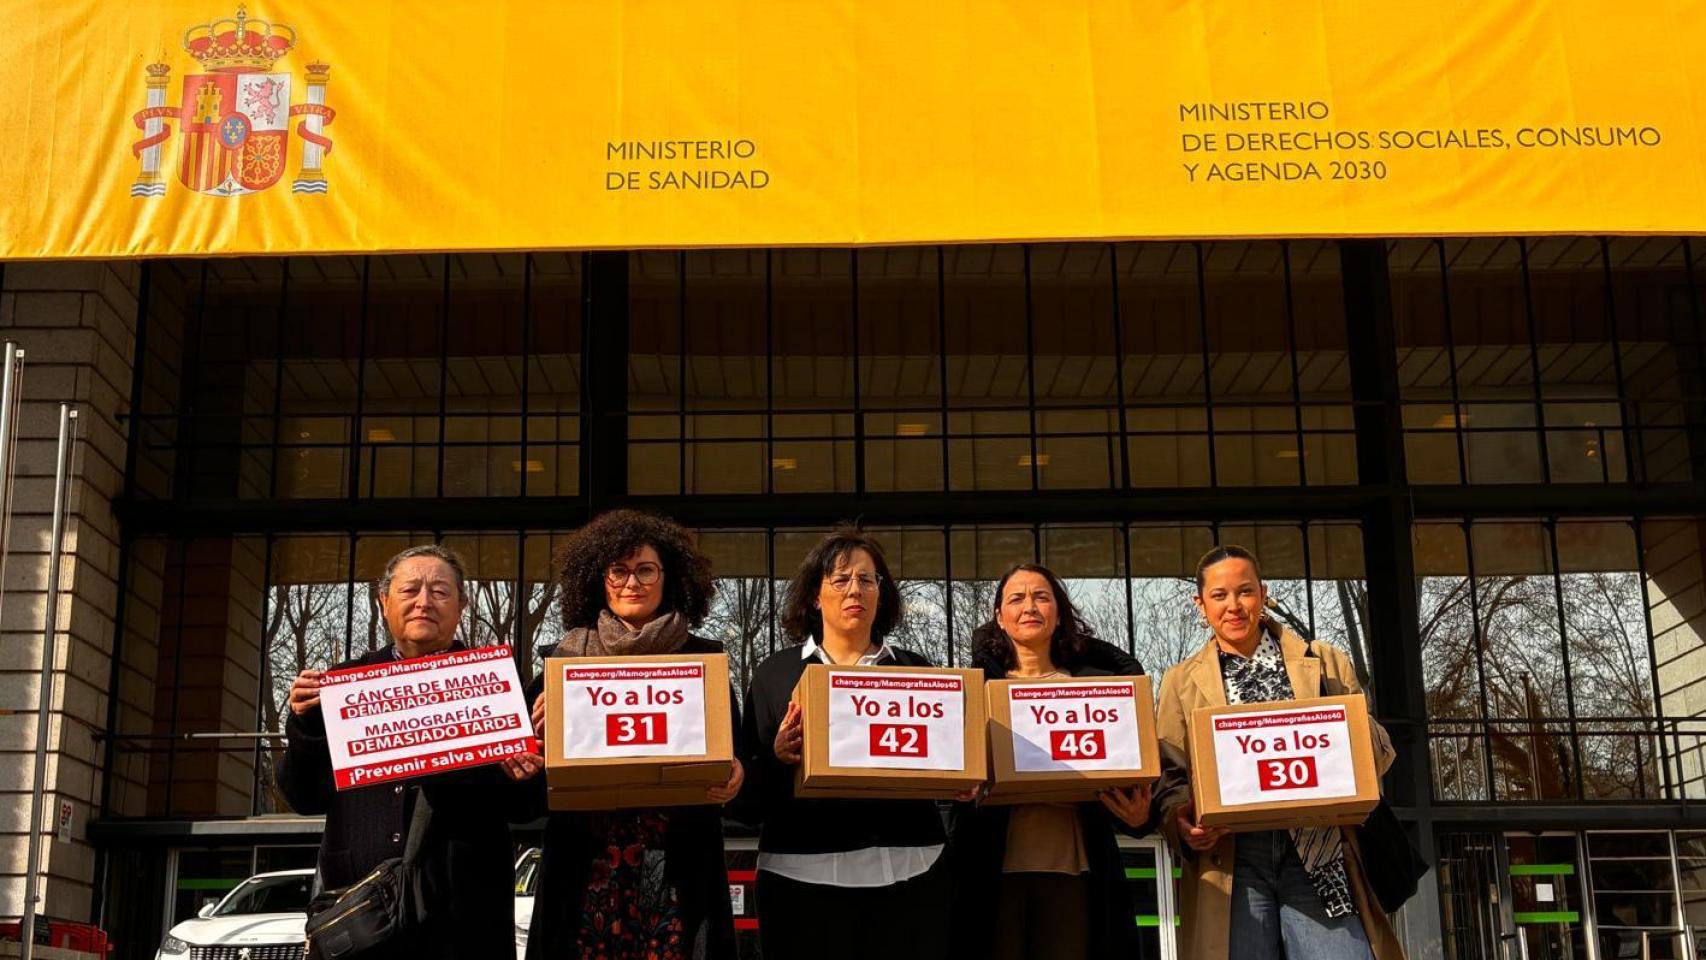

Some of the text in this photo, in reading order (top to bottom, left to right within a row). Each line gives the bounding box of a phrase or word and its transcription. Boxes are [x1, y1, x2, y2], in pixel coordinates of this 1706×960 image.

[1179, 101, 1329, 122] MINISTERIO
[606, 139, 756, 161] MINISTERIO
[1182, 127, 1661, 152] DE DERECHOS SOCIALES, CONSUMO
[606, 170, 770, 190] DE SANIDAD
[1183, 160, 1387, 182] Y AGENDA 2030
[345, 671, 500, 706] CÁNCER DE MAMA
[346, 682, 505, 718] DEMASIADO PRONTO
[586, 685, 684, 706] Yo a los
[851, 695, 944, 719] Yo a los
[1030, 703, 1119, 725] Yo a los
[364, 704, 493, 737] MAMOGRAFÍAS
[616, 716, 654, 742] 31
[351, 714, 518, 755] DEMASIADO TARDE
[879, 727, 919, 753] 42
[1059, 732, 1098, 757] 46
[1235, 730, 1331, 754] Yo a los
[349, 739, 528, 786] ¡Prevenir salva vidas!
[1267, 760, 1309, 787] 30
